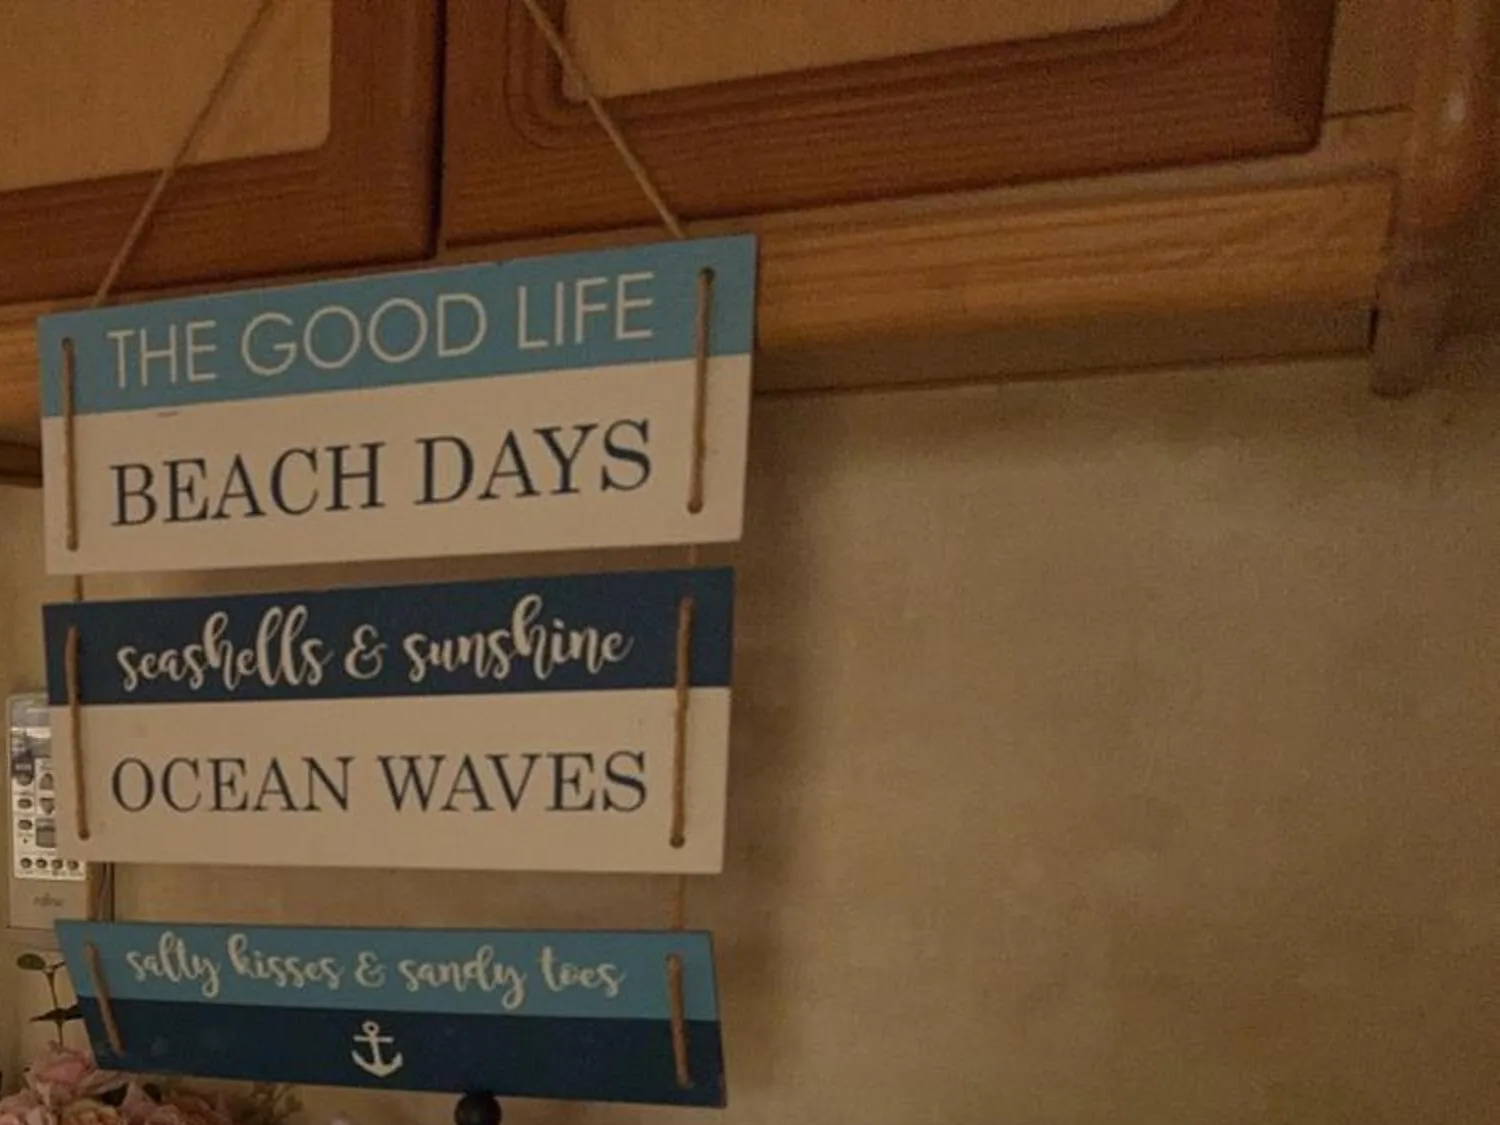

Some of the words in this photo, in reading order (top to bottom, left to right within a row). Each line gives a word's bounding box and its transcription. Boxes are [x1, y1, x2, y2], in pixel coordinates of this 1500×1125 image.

[107, 320, 217, 390] THE
[240, 293, 488, 377] GOOD
[517, 272, 655, 350] LIFE
[110, 440, 386, 527] BEACH
[414, 418, 652, 506] DAYS
[117, 606, 331, 691] seashells
[345, 624, 386, 679] &
[403, 594, 634, 682] sunshine
[111, 756, 356, 813] OCEAN
[377, 750, 647, 813] WAVES
[126, 932, 222, 997] salty
[227, 932, 344, 988] kisses
[354, 954, 386, 988] &
[397, 945, 526, 1010] sandy
[539, 945, 625, 998] toes
